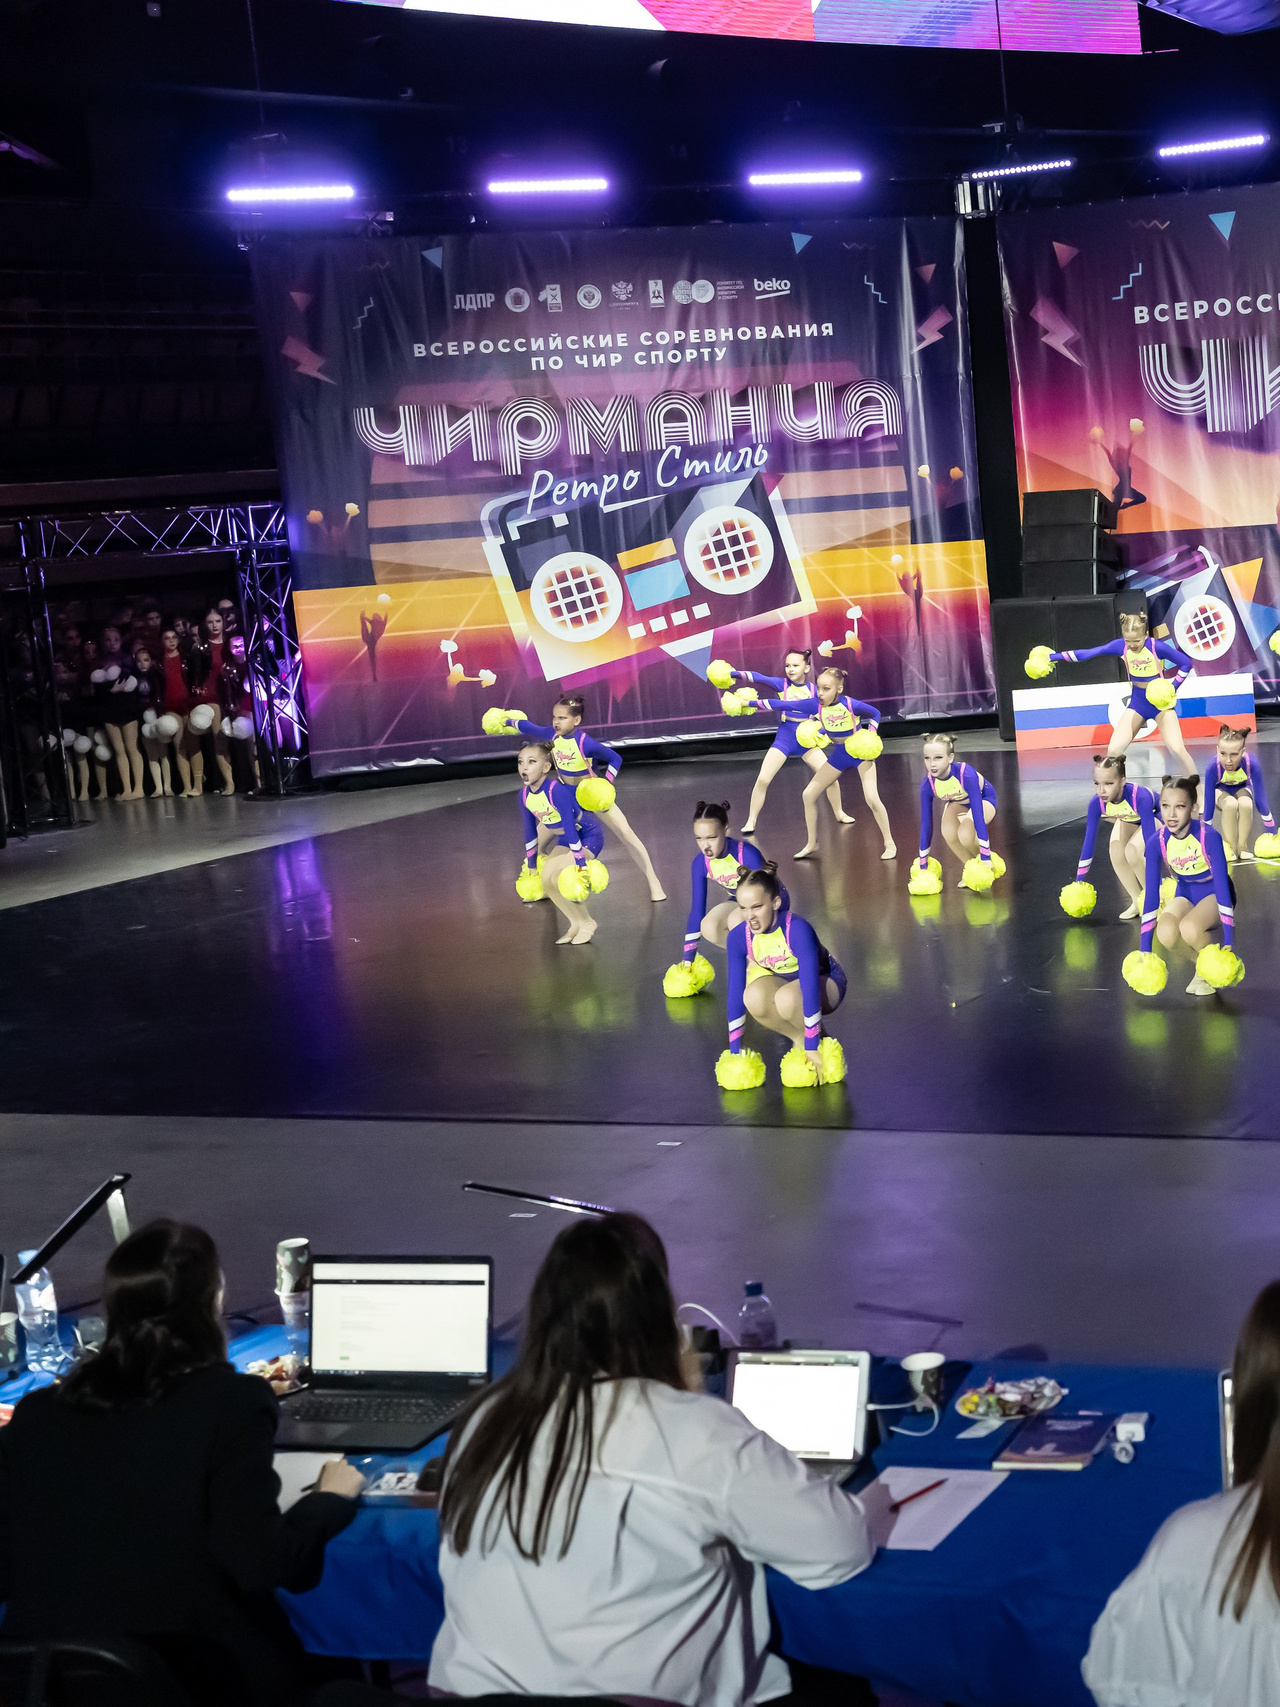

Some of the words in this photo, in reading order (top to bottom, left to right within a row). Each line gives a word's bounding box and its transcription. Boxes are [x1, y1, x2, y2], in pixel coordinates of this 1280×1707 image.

[754, 278, 791, 291] beko
[453, 293, 496, 311] ЛДПР
[412, 332, 630, 358] ВСЕРОССИЙСКИЕ
[639, 321, 835, 347] СОРЕВНОВАНИЯ
[531, 352, 567, 371] ПО
[574, 348, 626, 369] ЧИР
[633, 345, 729, 367] СПОРТУ
[527, 467, 640, 515] Ретро
[655, 442, 769, 490] Стиль
